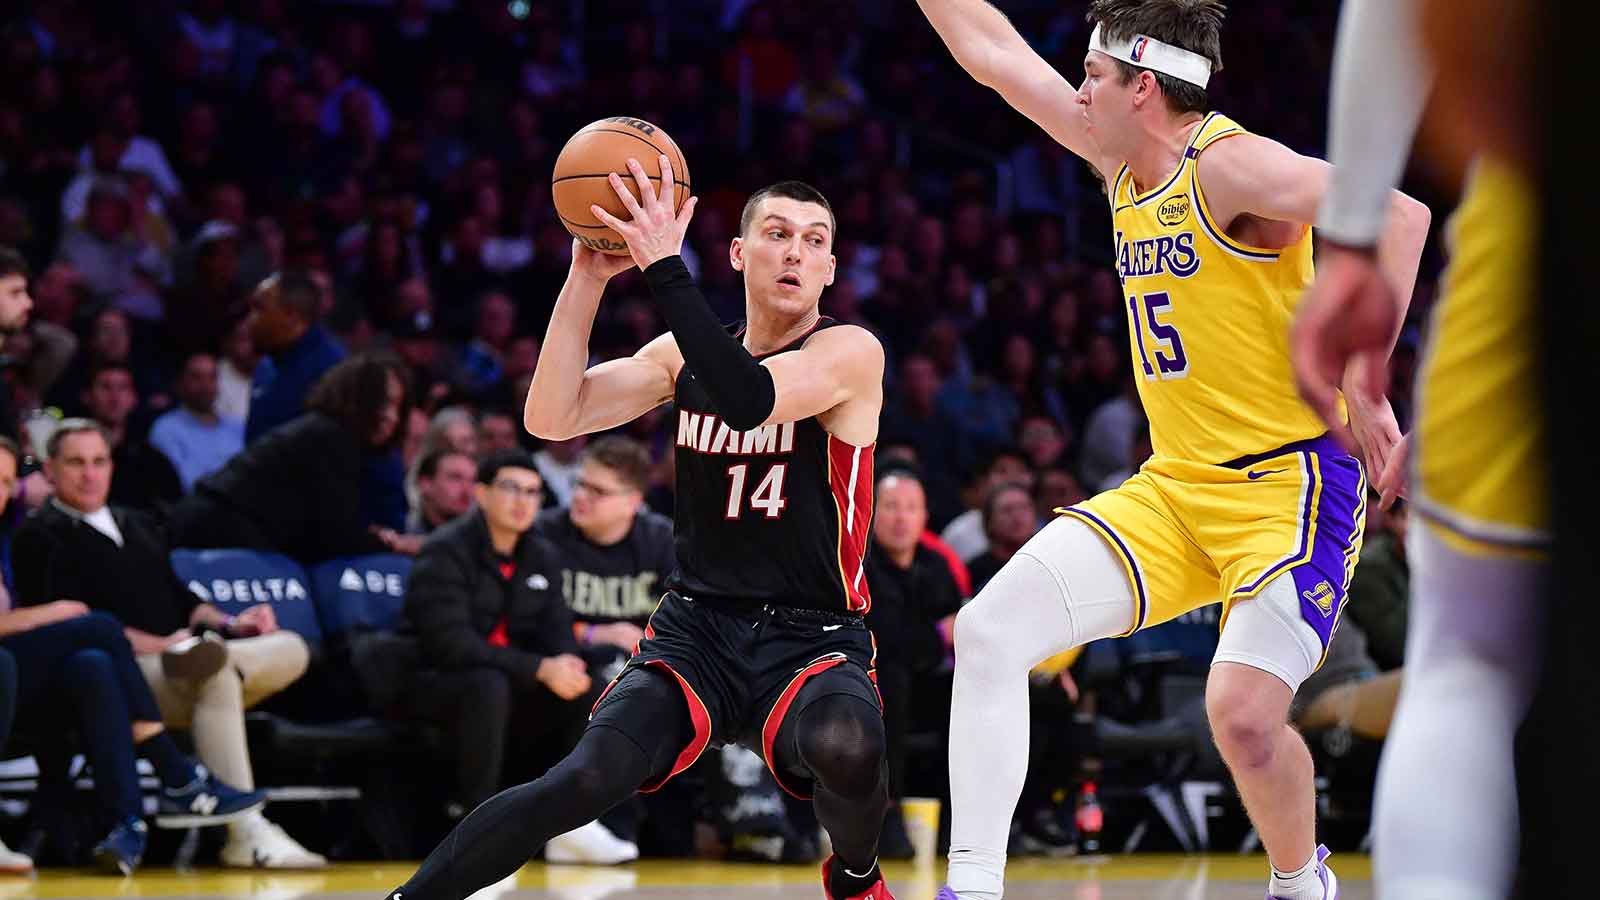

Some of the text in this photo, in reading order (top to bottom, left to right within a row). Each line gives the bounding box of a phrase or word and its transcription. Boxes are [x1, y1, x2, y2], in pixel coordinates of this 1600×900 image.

[1161, 202, 1189, 216] bibigo
[1129, 292, 1189, 380] 15
[675, 408, 796, 454] MIAMI
[724, 462, 788, 520] 14
[211, 578, 307, 602] DELTA
